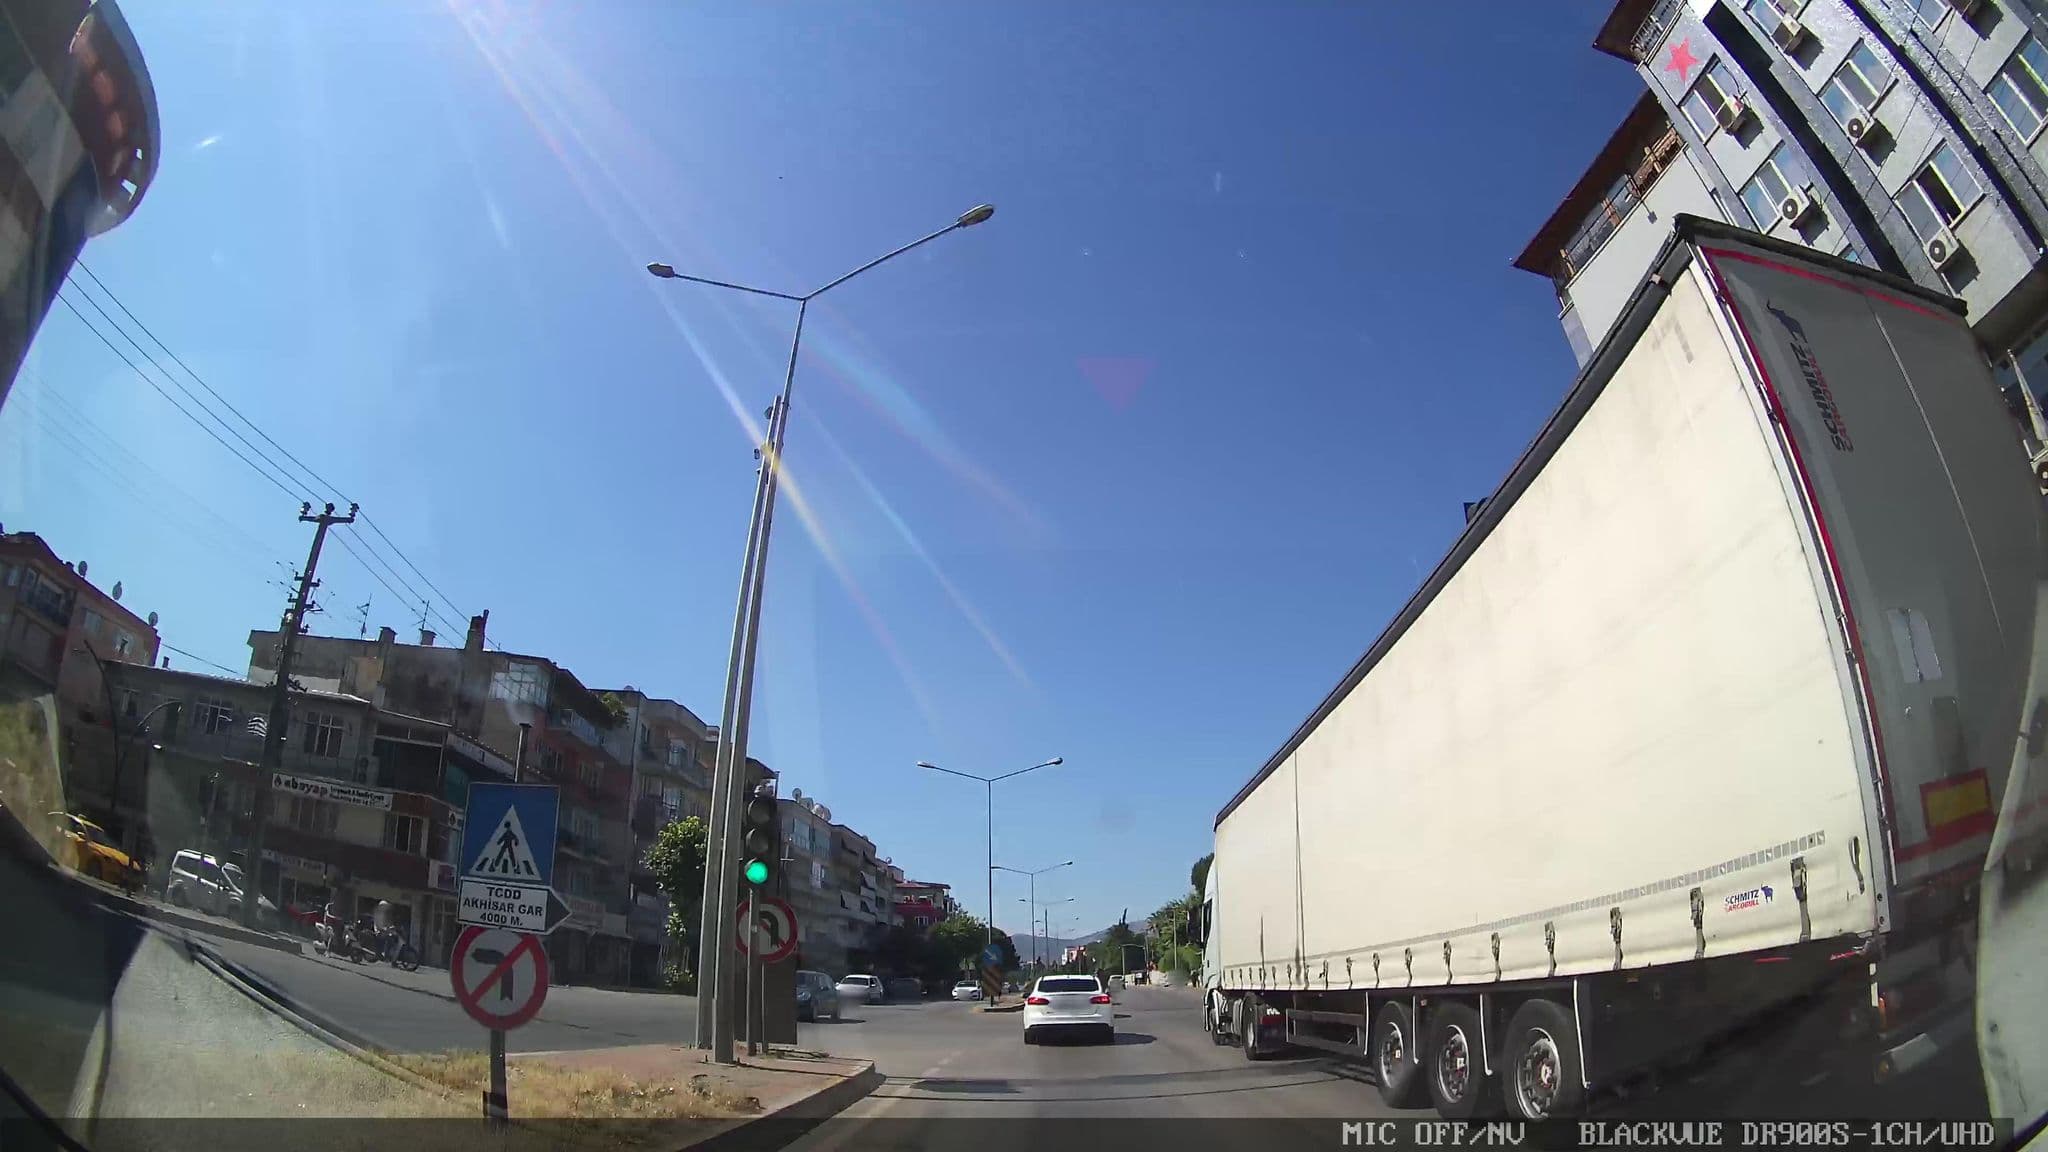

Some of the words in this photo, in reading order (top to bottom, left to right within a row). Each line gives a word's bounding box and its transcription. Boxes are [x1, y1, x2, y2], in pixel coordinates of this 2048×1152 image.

[1790, 341, 1846, 451] SCHMITZ
[486, 886, 522, 900] TCDD
[1725, 889, 1760, 905] SCHMITZ
[463, 897, 515, 913] AKHİSAR
[518, 904, 543, 916] GAR
[480, 912, 508, 925] 4000
[510, 916, 523, 926] M.
